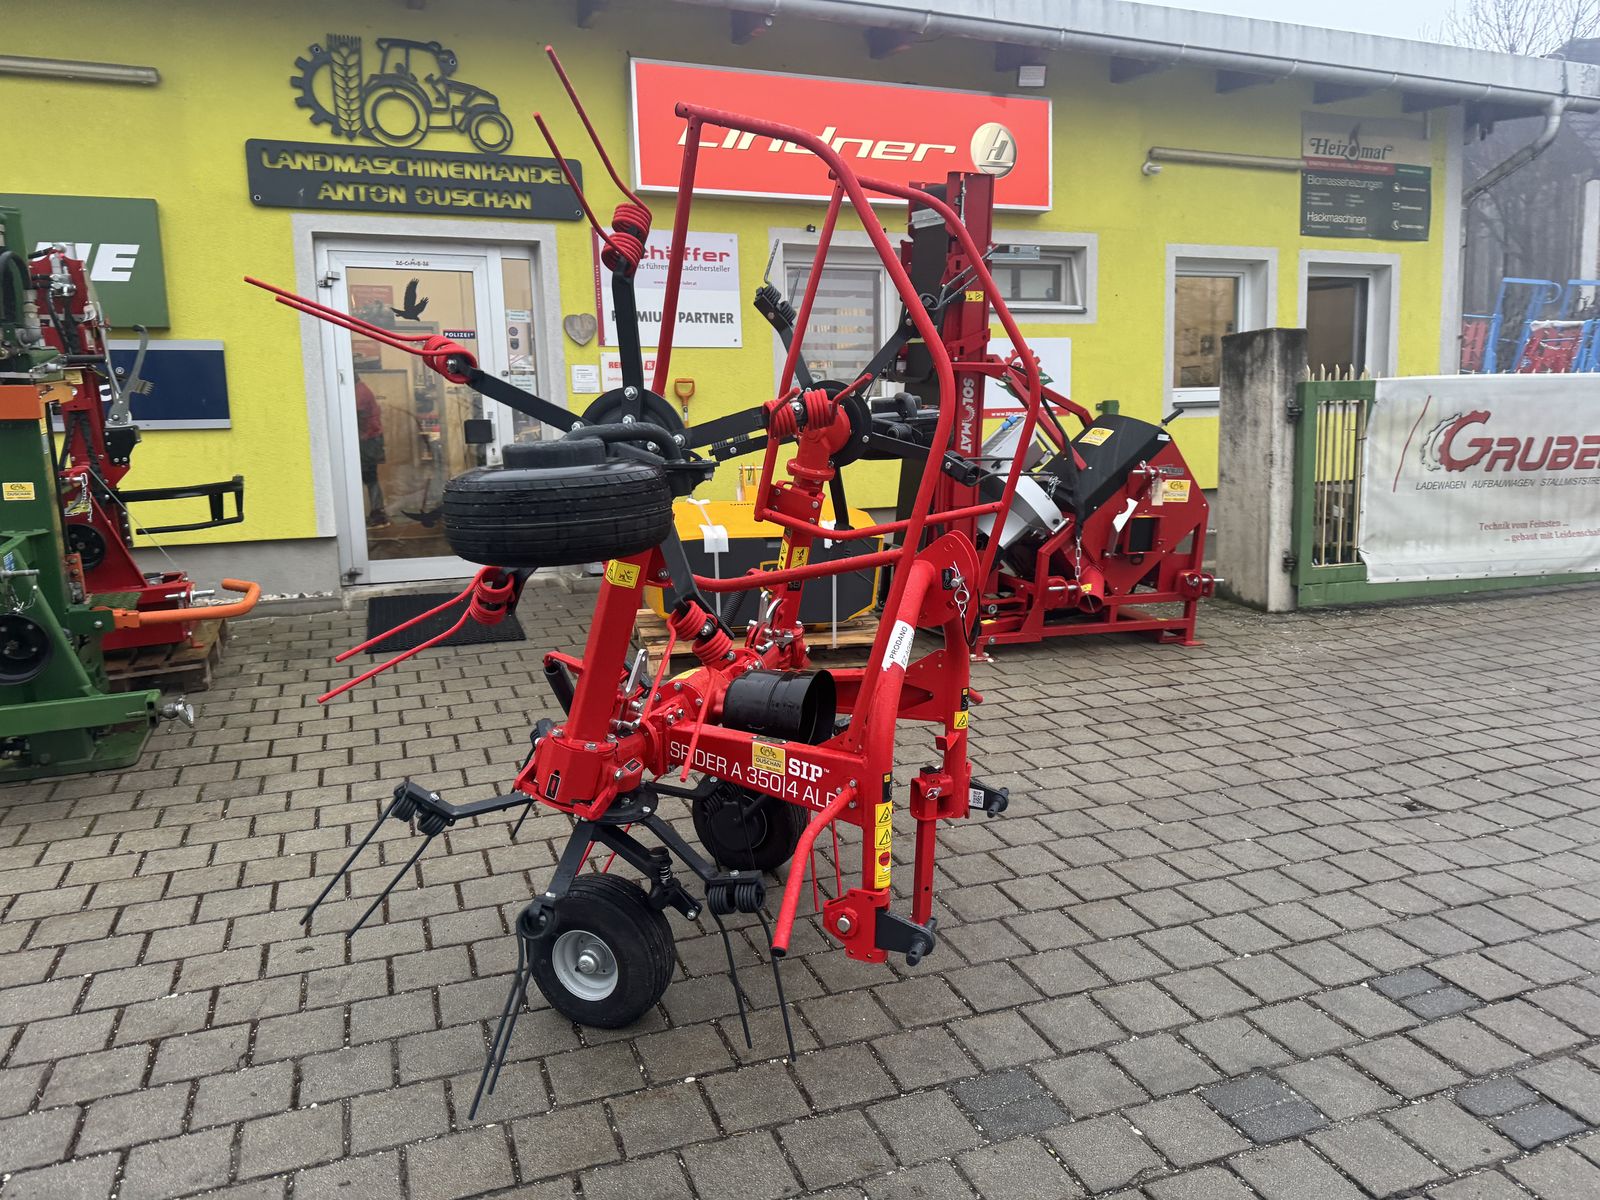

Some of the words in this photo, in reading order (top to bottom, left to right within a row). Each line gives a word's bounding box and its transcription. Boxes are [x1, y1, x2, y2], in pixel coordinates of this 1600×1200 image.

[317, 181, 407, 204] ANTON
[415, 187, 532, 210] OUSCHAN
[678, 312, 734, 324] PARTNER
[1438, 410, 1600, 473] GRUBE
[1415, 479, 1467, 491] LADEWAGEN
[1471, 479, 1535, 489] AUFBAUWAGEN
[730, 761, 742, 780] A
